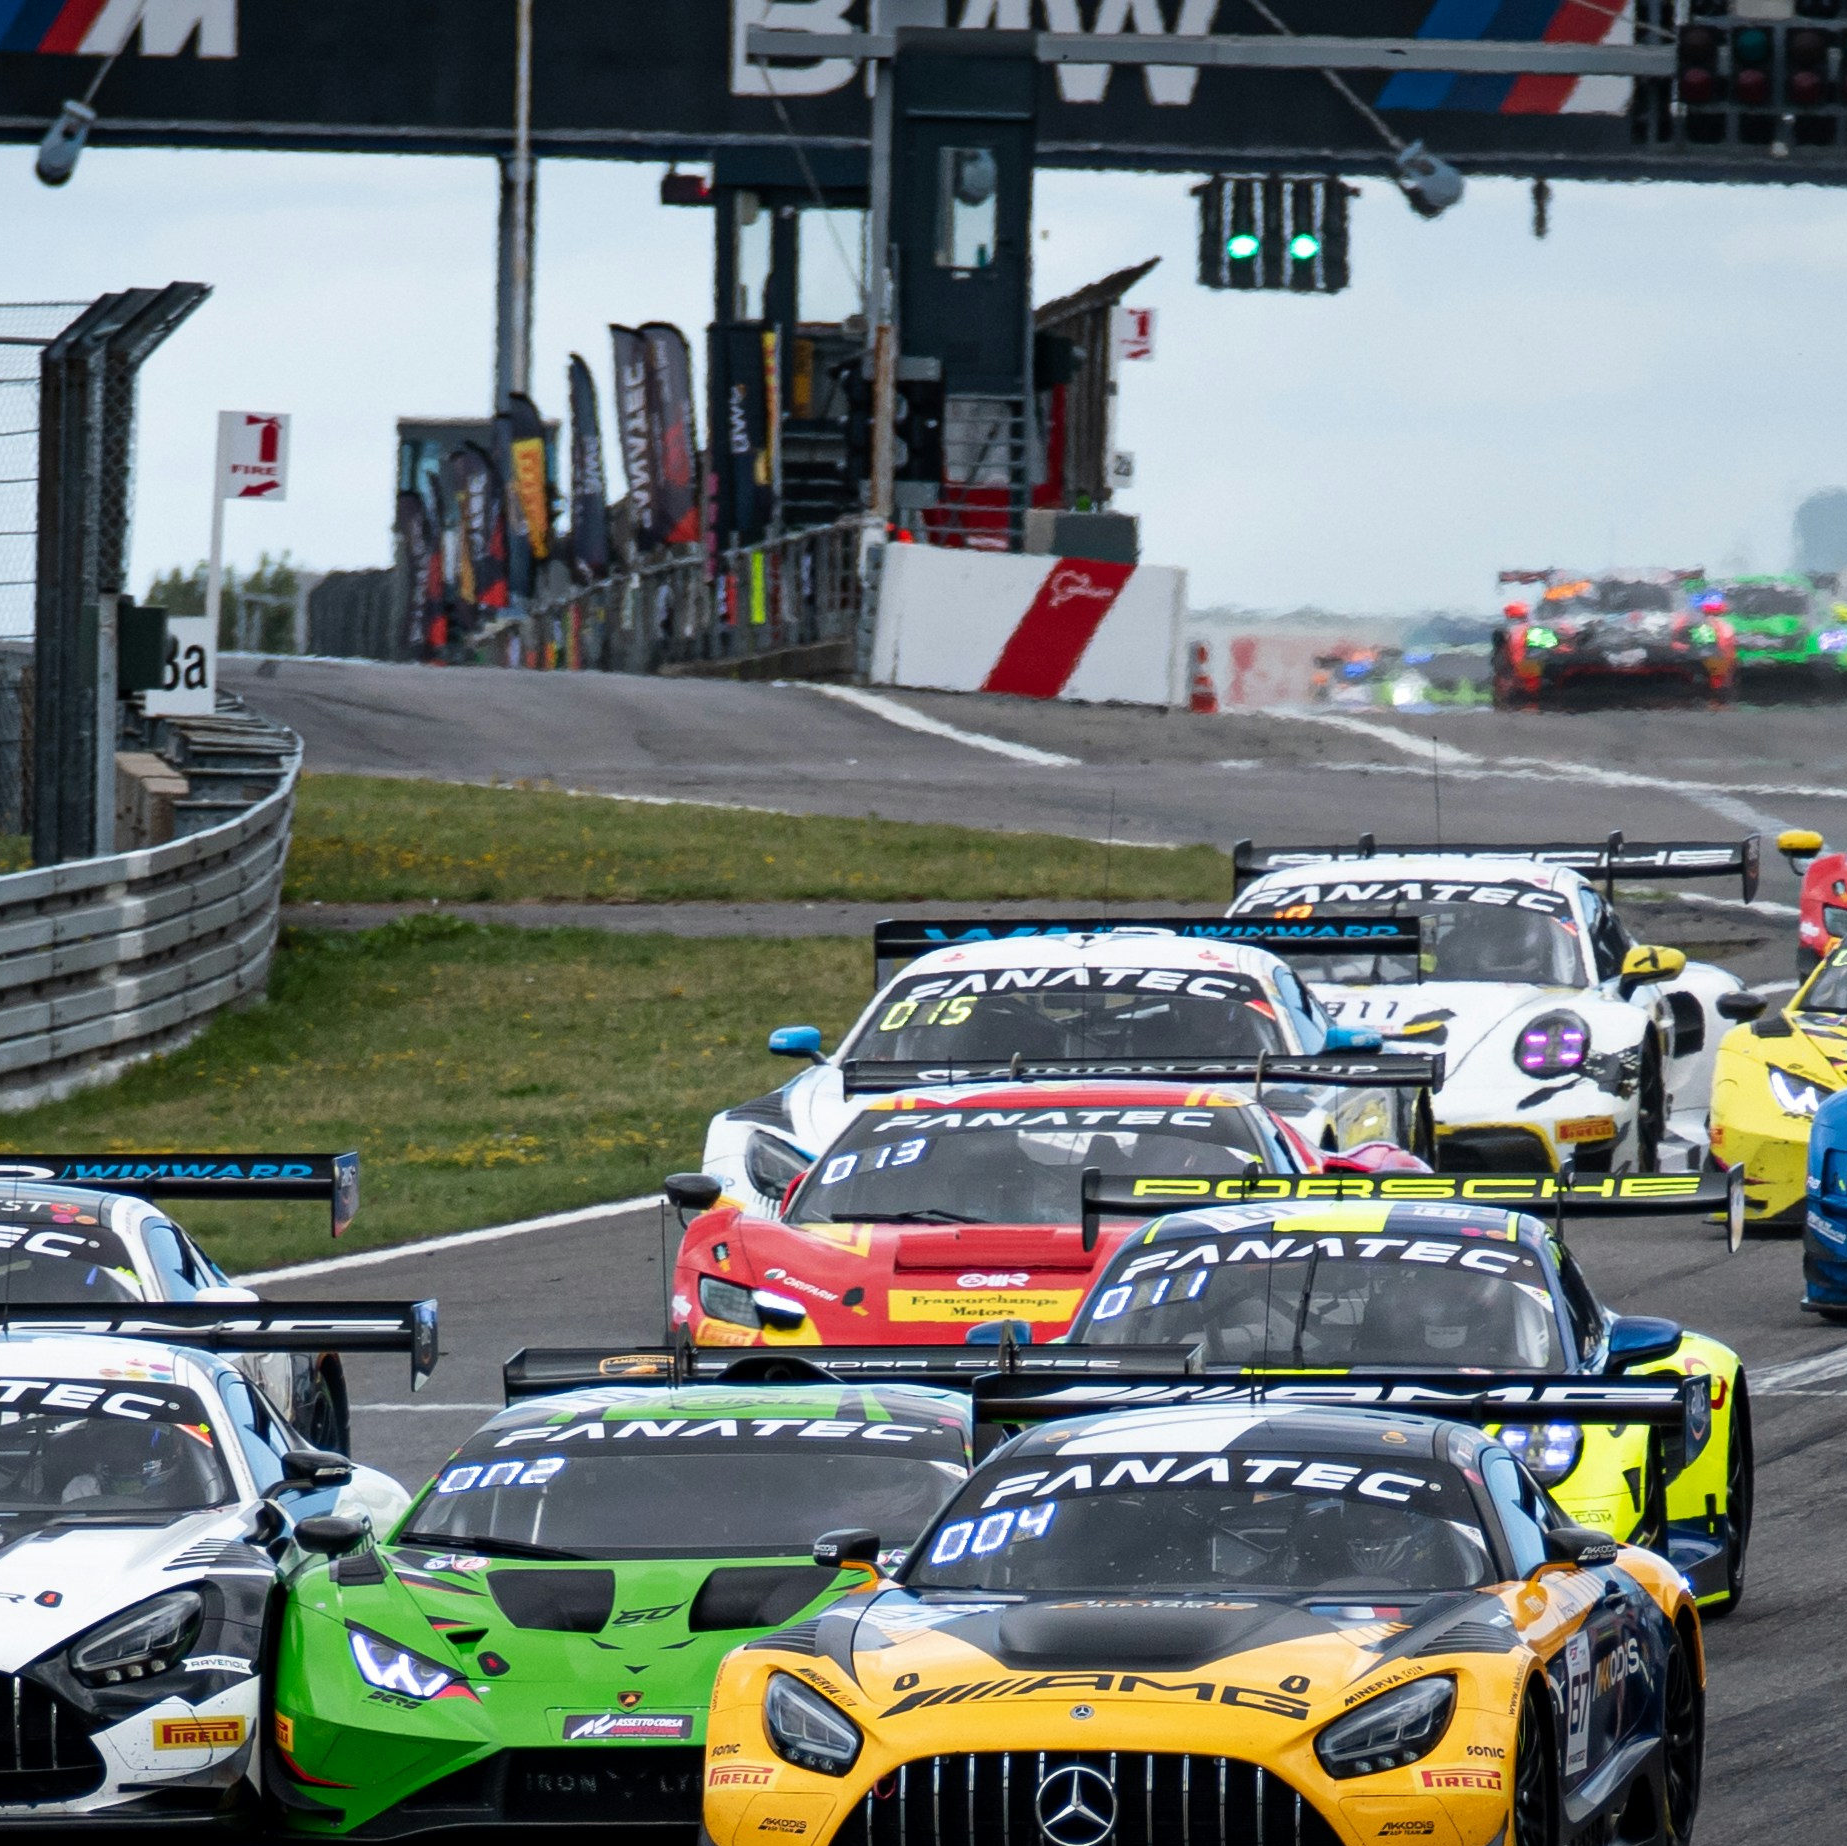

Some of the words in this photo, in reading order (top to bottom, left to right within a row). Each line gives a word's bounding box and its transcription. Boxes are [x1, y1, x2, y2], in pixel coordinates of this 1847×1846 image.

[230, 463, 279, 476] FIRE
[1239, 881, 1567, 915] FANATEC
[906, 967, 1237, 1001] FANATEC
[880, 997, 978, 1033] 015
[874, 1111, 1215, 1133] FANATEC
[821, 1138, 927, 1185] 013
[1131, 1175, 1703, 1200] PORSCHE
[1116, 1238, 1527, 1282] FANATEC
[782, 1276, 840, 1302] ORIFARM
[910, 1294, 1059, 1307] Francorchamps
[1092, 1269, 1209, 1321] 011
[950, 1306, 1016, 1318] Motors
[494, 1419, 927, 1448] FANATEC
[982, 1458, 1426, 1509] FANATEC
[931, 1502, 1056, 1564] 004
[190, 1657, 248, 1670] RAVENOL
[795, 1666, 840, 1696] MINERVA
[1344, 1672, 1403, 1707] MINERVA
[1012, 1674, 1310, 1721] AMG
[1569, 1671, 1590, 1736] 87
[162, 1721, 240, 1745] PIRELLI
[616, 1717, 654, 1728] ASSETTO
[654, 1718, 683, 1728] CORSA
[1466, 1744, 1506, 1759] SONIC
[707, 1764, 775, 1788] PIRELLI
[1420, 1767, 1504, 1791] PIRELLI
[760, 1817, 807, 1829] AKKODIS
[1381, 1820, 1435, 1831] AKKODIS
